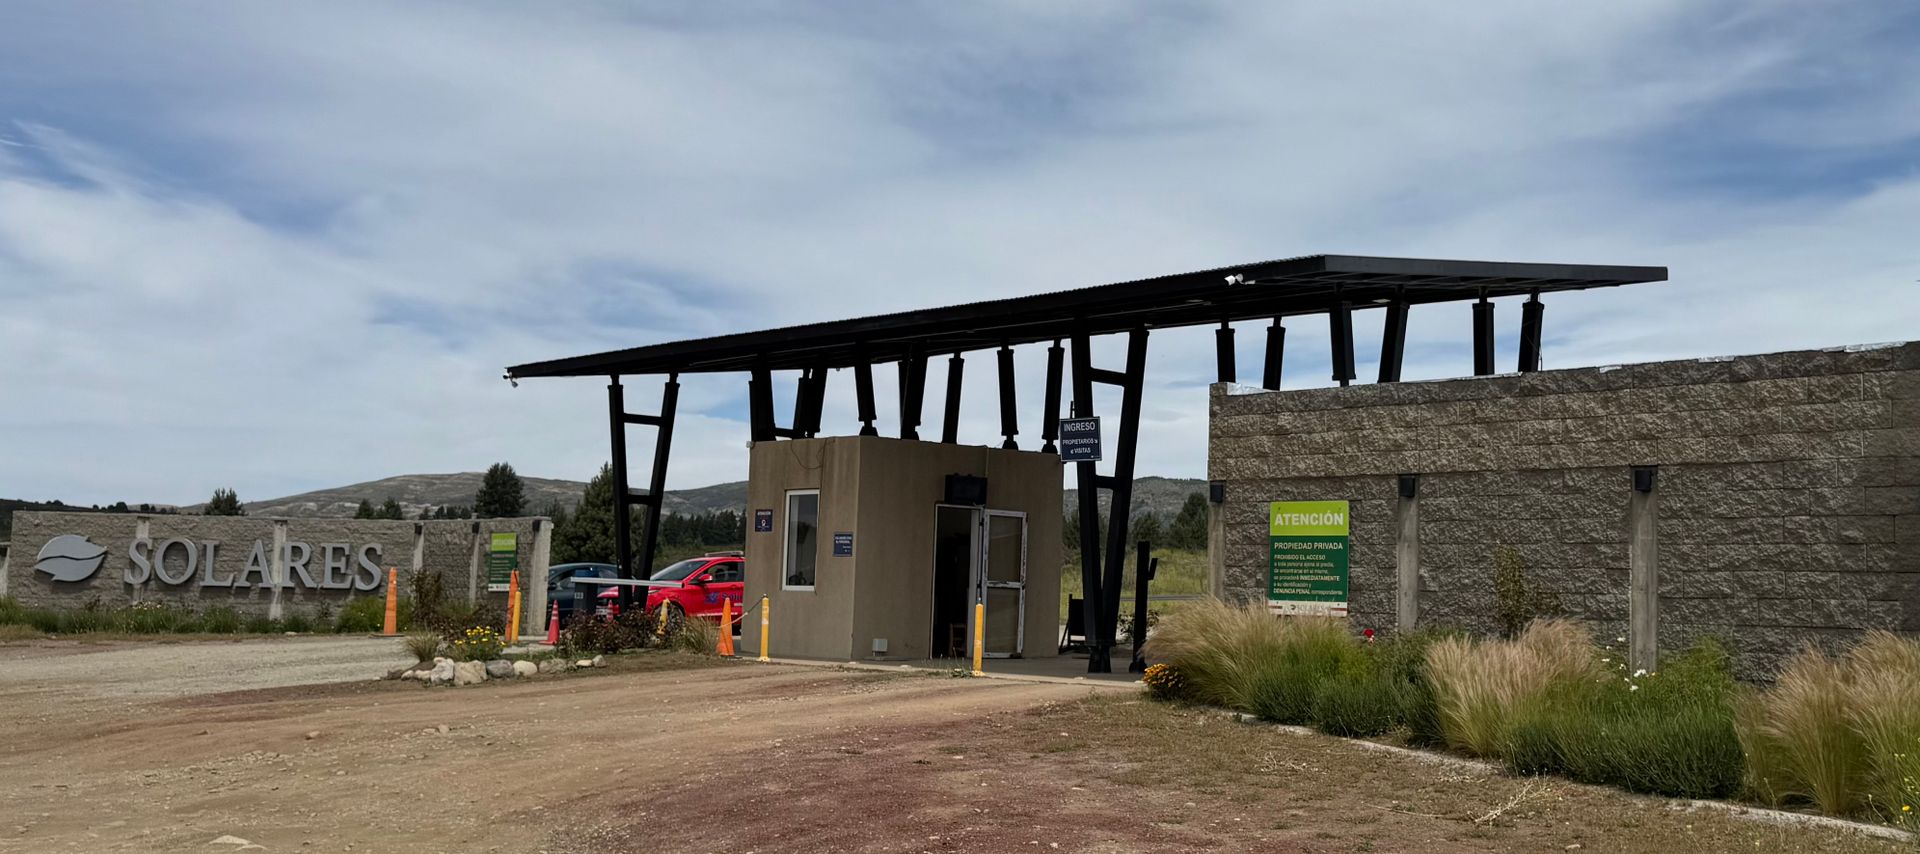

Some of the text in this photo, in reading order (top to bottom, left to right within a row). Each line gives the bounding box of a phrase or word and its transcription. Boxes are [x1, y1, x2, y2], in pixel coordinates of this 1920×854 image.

[1064, 421, 1095, 431] INGRESO
[1274, 510, 1344, 526] ATENCIÓN
[1274, 542, 1343, 550] PROPIEDAD PRIVADA
[124, 537, 383, 591] SOLARES
